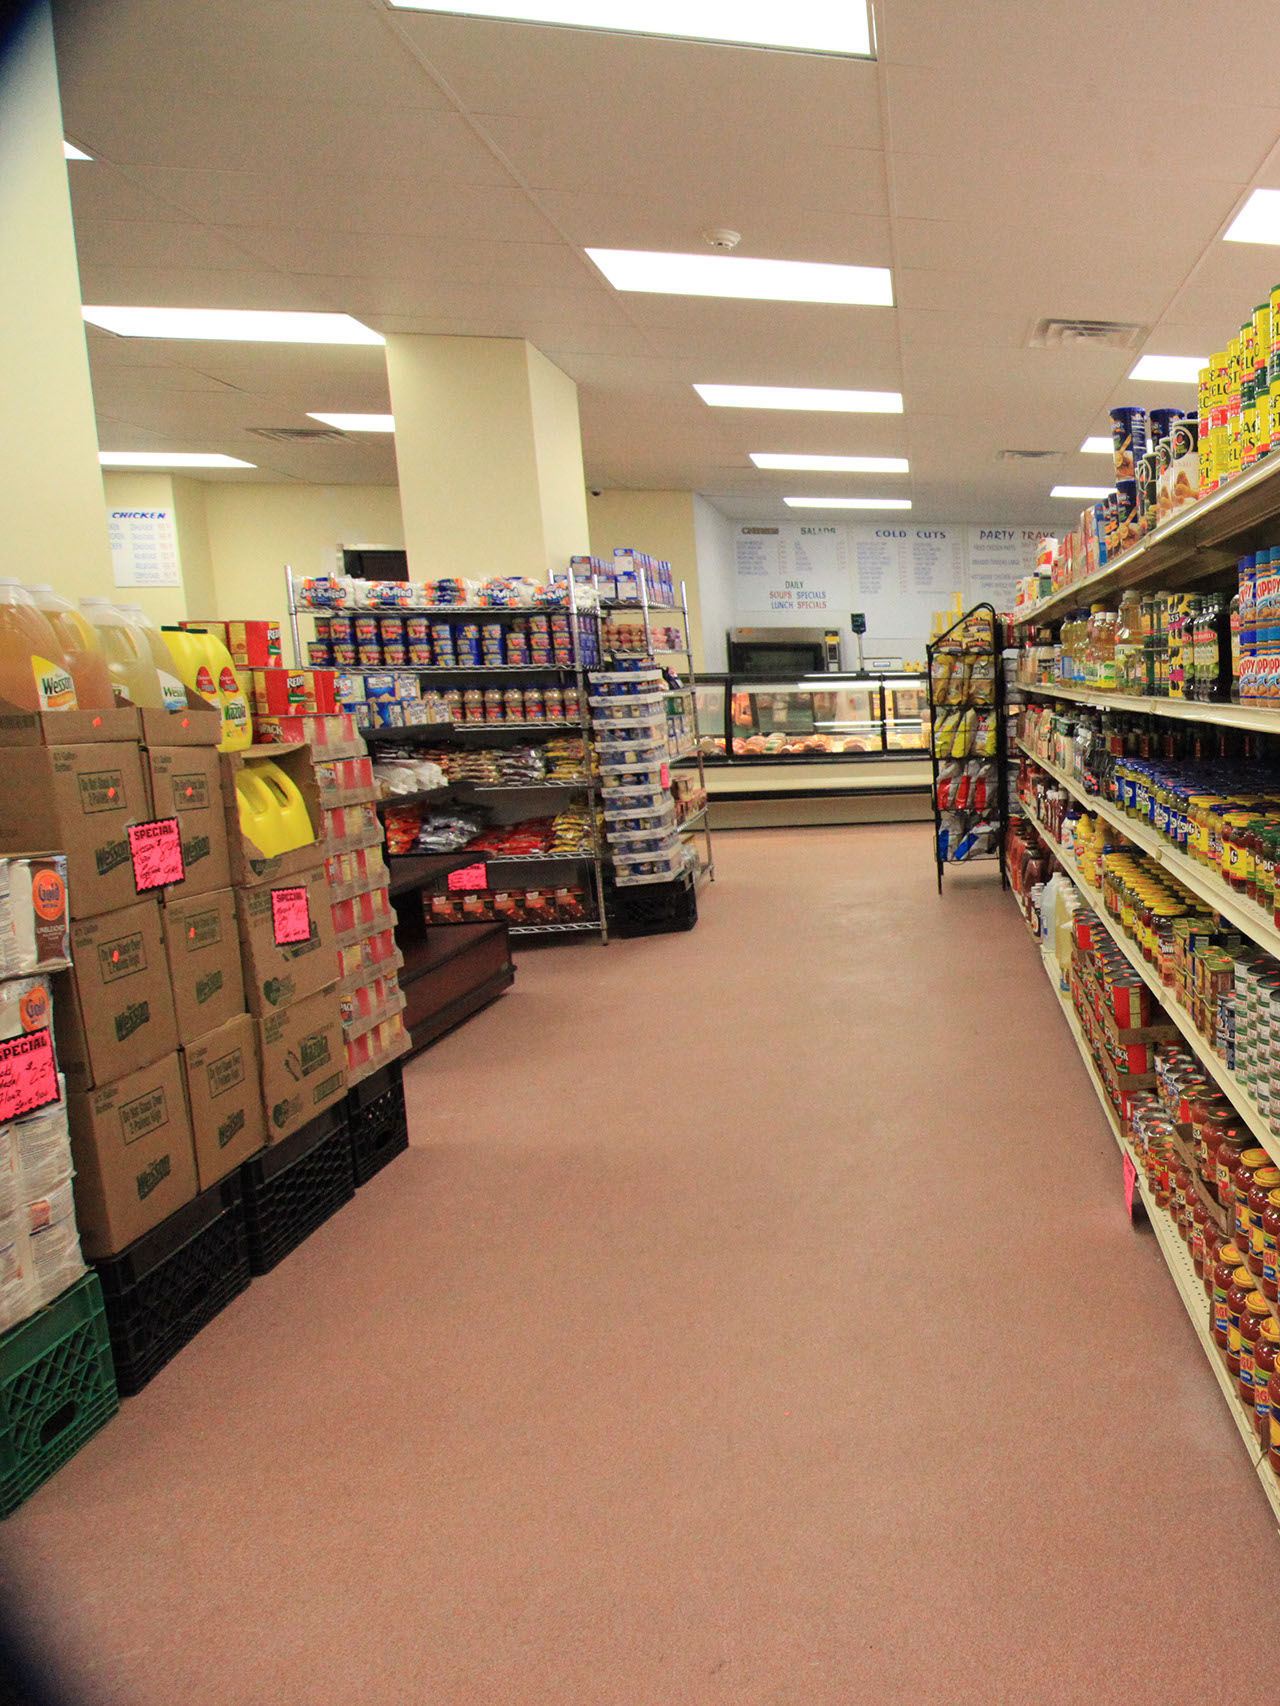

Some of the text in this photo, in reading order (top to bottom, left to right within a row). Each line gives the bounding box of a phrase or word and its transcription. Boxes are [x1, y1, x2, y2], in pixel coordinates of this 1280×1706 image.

[111, 510, 166, 520] CHICKEN
[875, 529, 946, 539] COLD CUTS
[980, 530, 1015, 540] PARTY
[785, 581, 804, 590] DAILY
[769, 591, 827, 599] SOUPS SPECIALS
[771, 600, 827, 609] LUNCH SPECIALS
[134, 825, 174, 840] SPECIAL
[276, 893, 303, 903] SPECIAL
